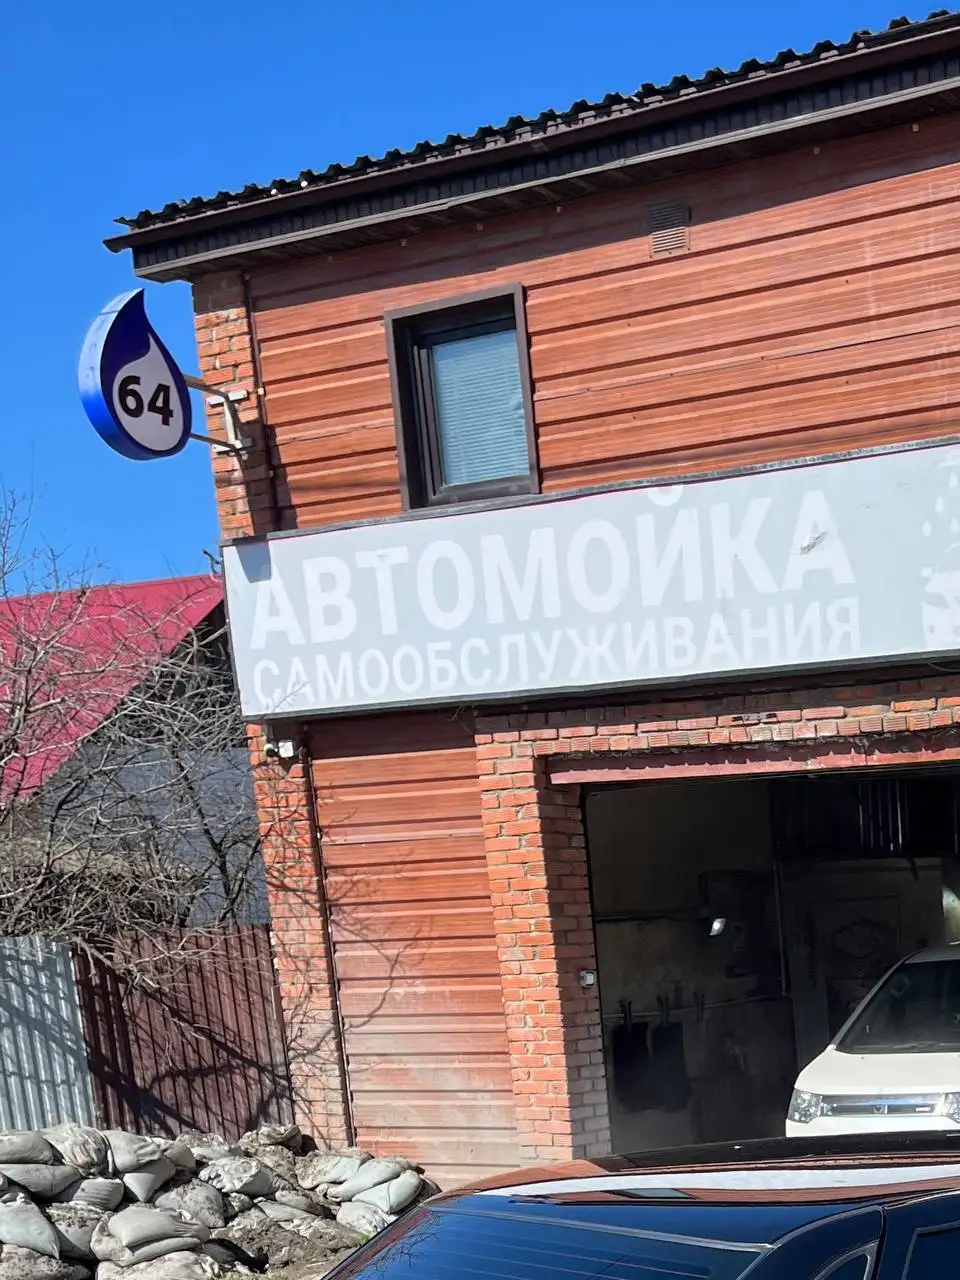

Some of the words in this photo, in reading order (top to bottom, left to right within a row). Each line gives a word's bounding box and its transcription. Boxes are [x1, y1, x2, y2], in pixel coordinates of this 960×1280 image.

[118, 375, 174, 427] 64
[249, 485, 856, 650] АВТОМОЙКА
[253, 596, 860, 709] САМООБСЛУЖИВАНИЯ
